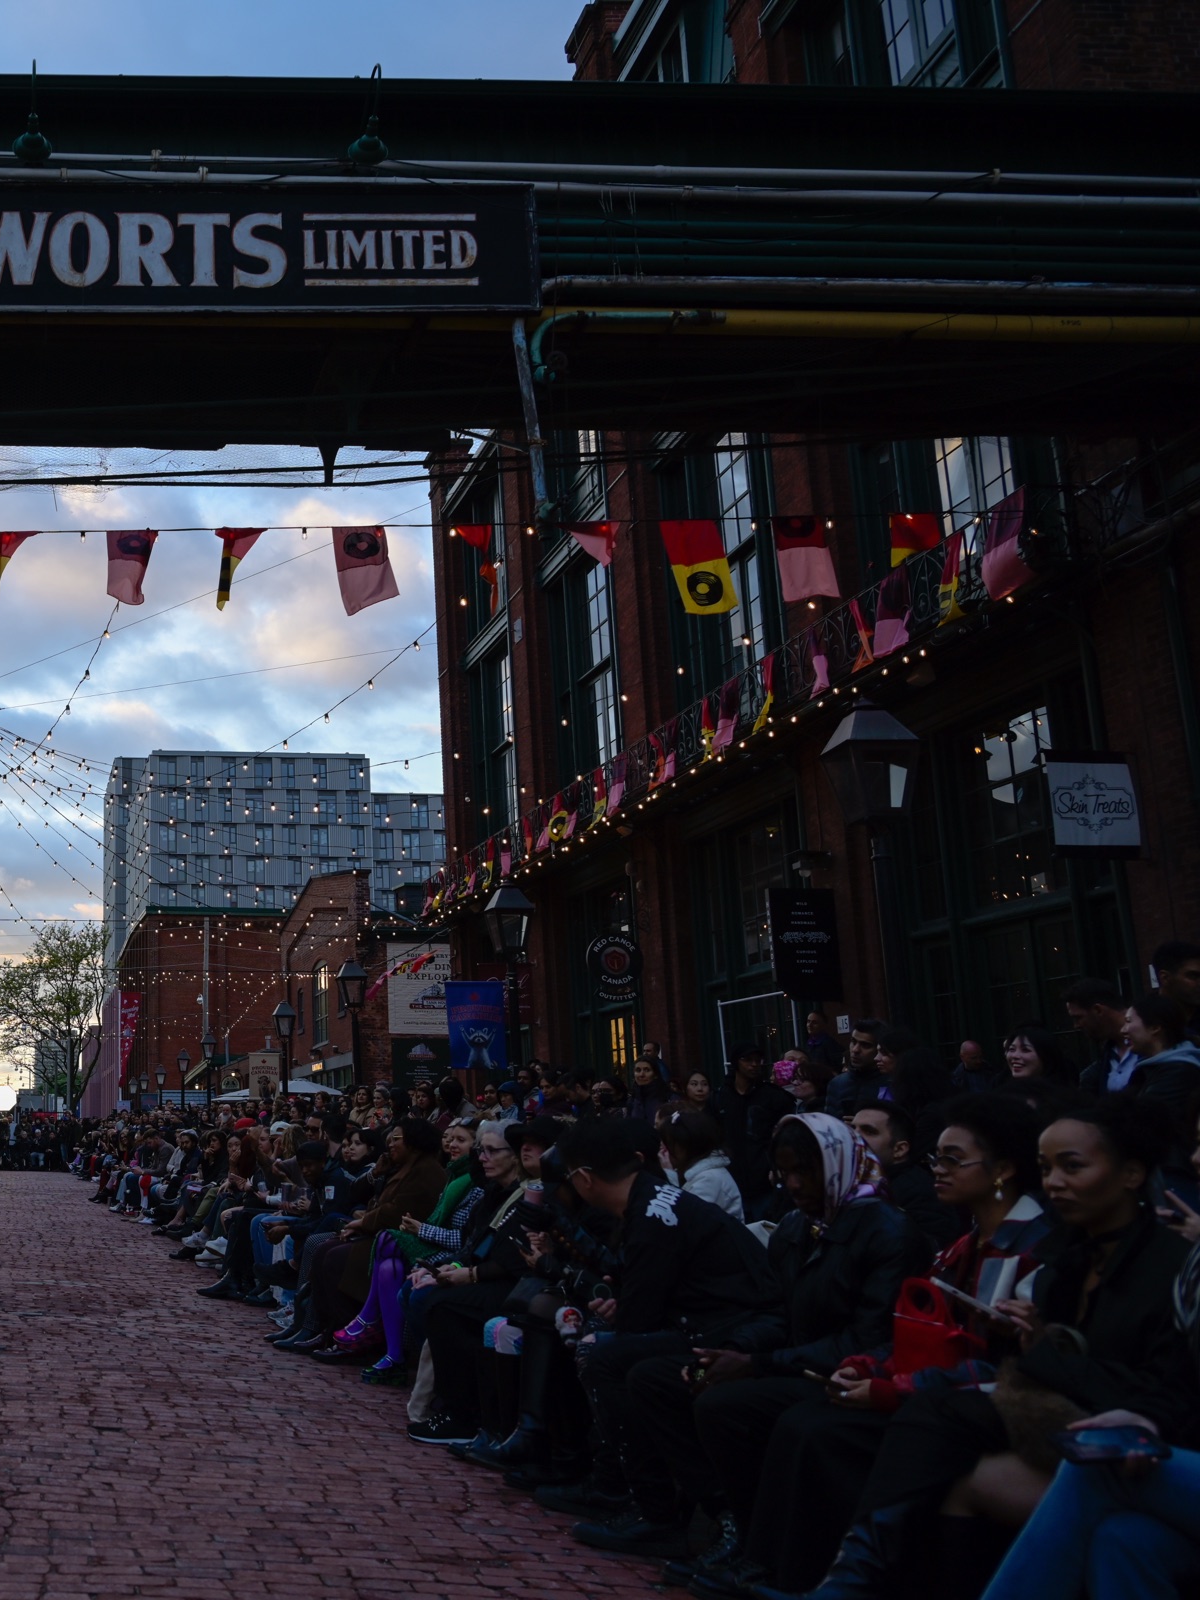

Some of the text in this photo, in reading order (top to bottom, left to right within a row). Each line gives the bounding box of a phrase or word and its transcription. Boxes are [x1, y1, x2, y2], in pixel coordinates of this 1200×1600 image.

[303, 229, 479, 271] LIMITED
[1057, 792, 1130, 815] Skin Treats
[593, 936, 636, 953] RED CANOE
[406, 973, 451, 981] EXPLOR
[601, 974, 634, 985] CANADA
[599, 992, 637, 1001] OUTFITTER
